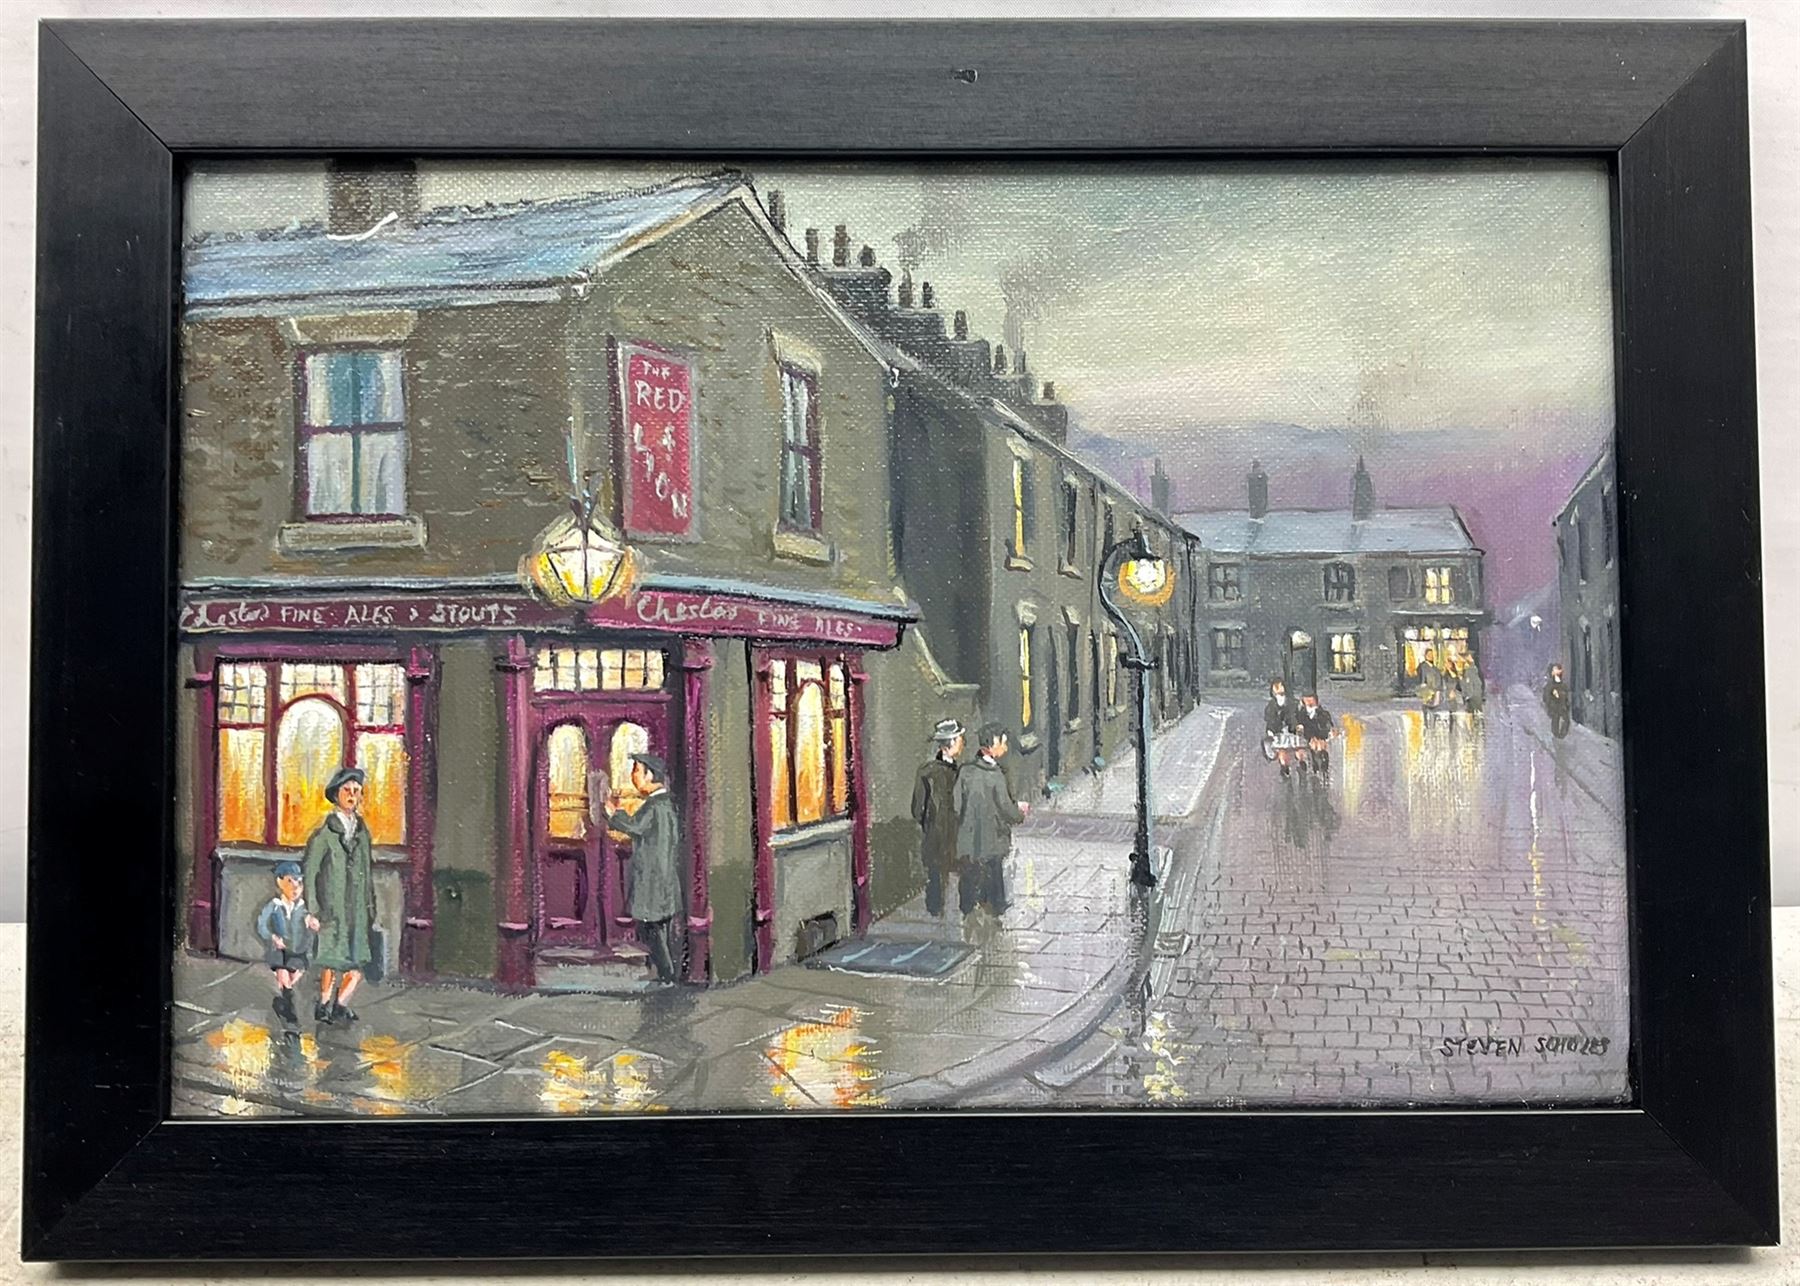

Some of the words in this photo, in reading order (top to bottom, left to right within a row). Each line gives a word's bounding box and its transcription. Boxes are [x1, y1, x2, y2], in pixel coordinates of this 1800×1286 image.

[641, 361, 671, 379] THE
[634, 379, 687, 413] RED
[633, 422, 688, 519] LION
[345, 606, 396, 625] ALES
[429, 602, 517, 625] STOUTS
[758, 609, 801, 631] FINE
